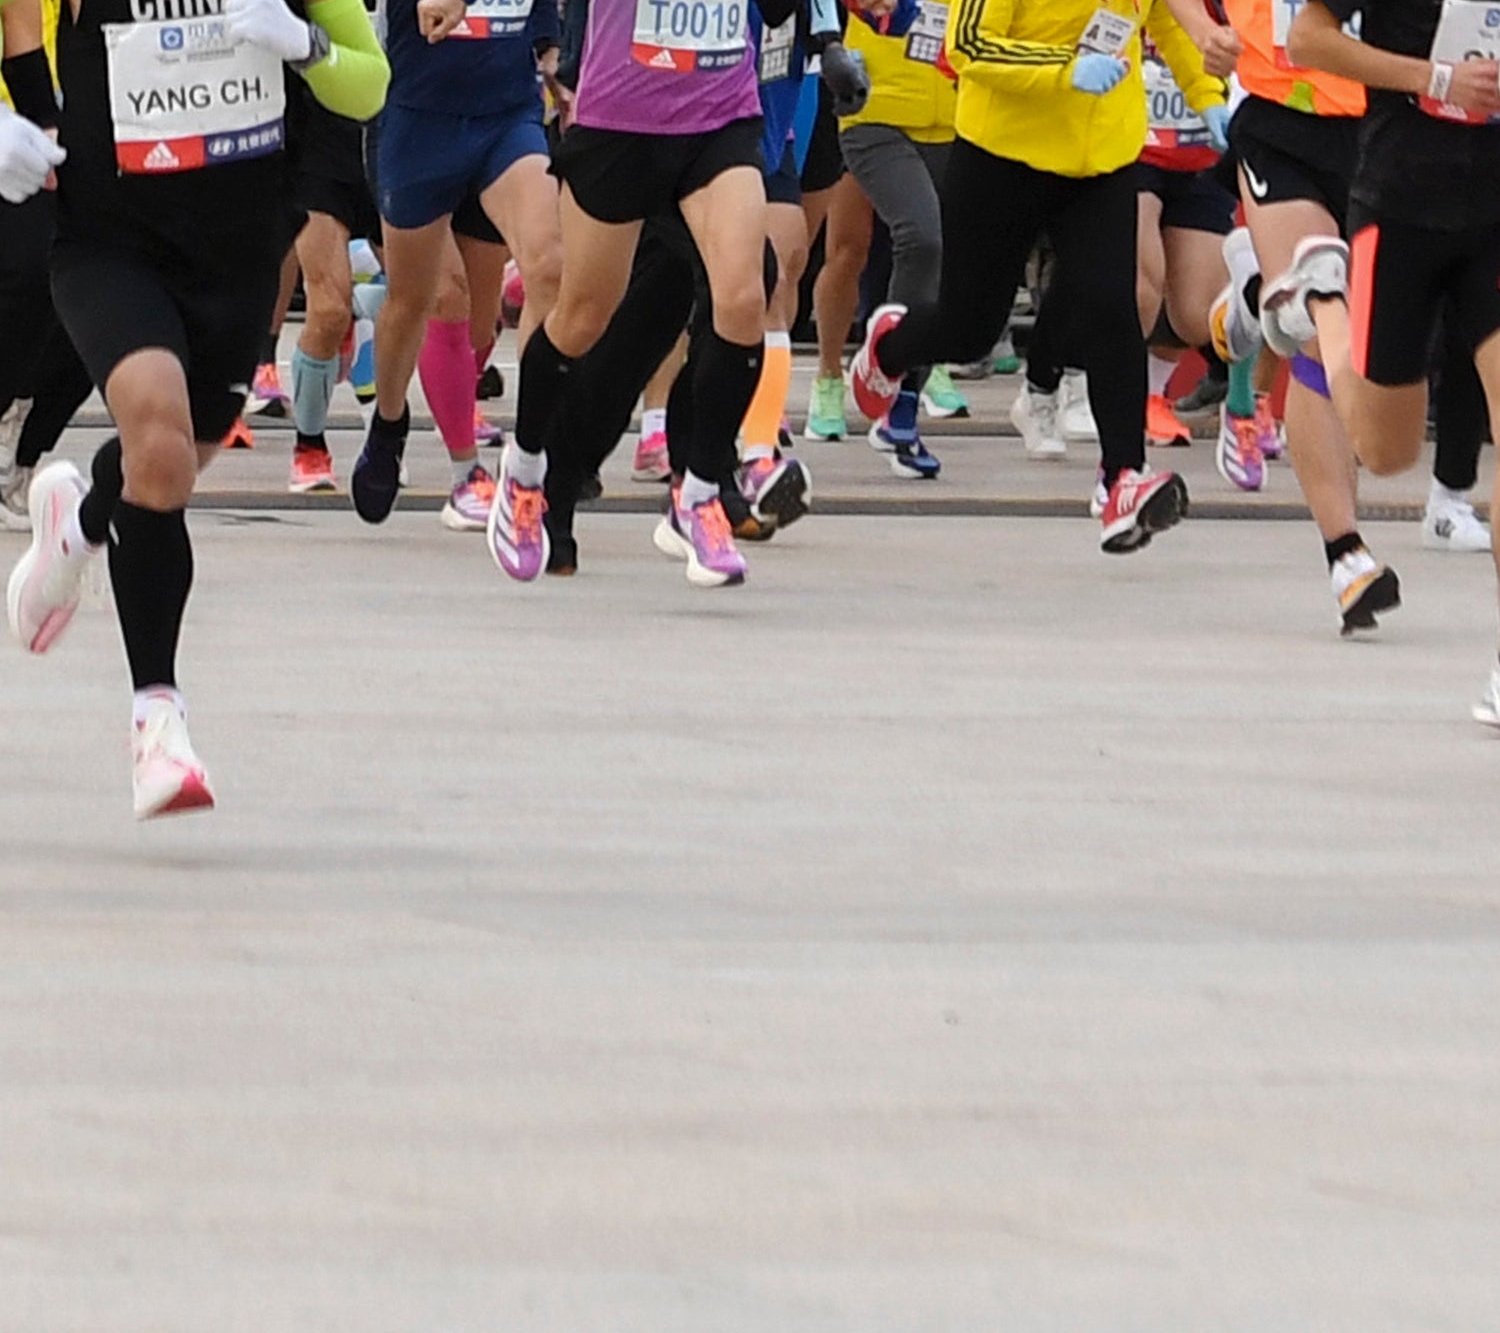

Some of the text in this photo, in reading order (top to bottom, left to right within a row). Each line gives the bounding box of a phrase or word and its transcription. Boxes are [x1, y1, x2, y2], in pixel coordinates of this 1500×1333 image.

[648, 0, 741, 40] T0019
[127, 76, 269, 115] YANG CH.
